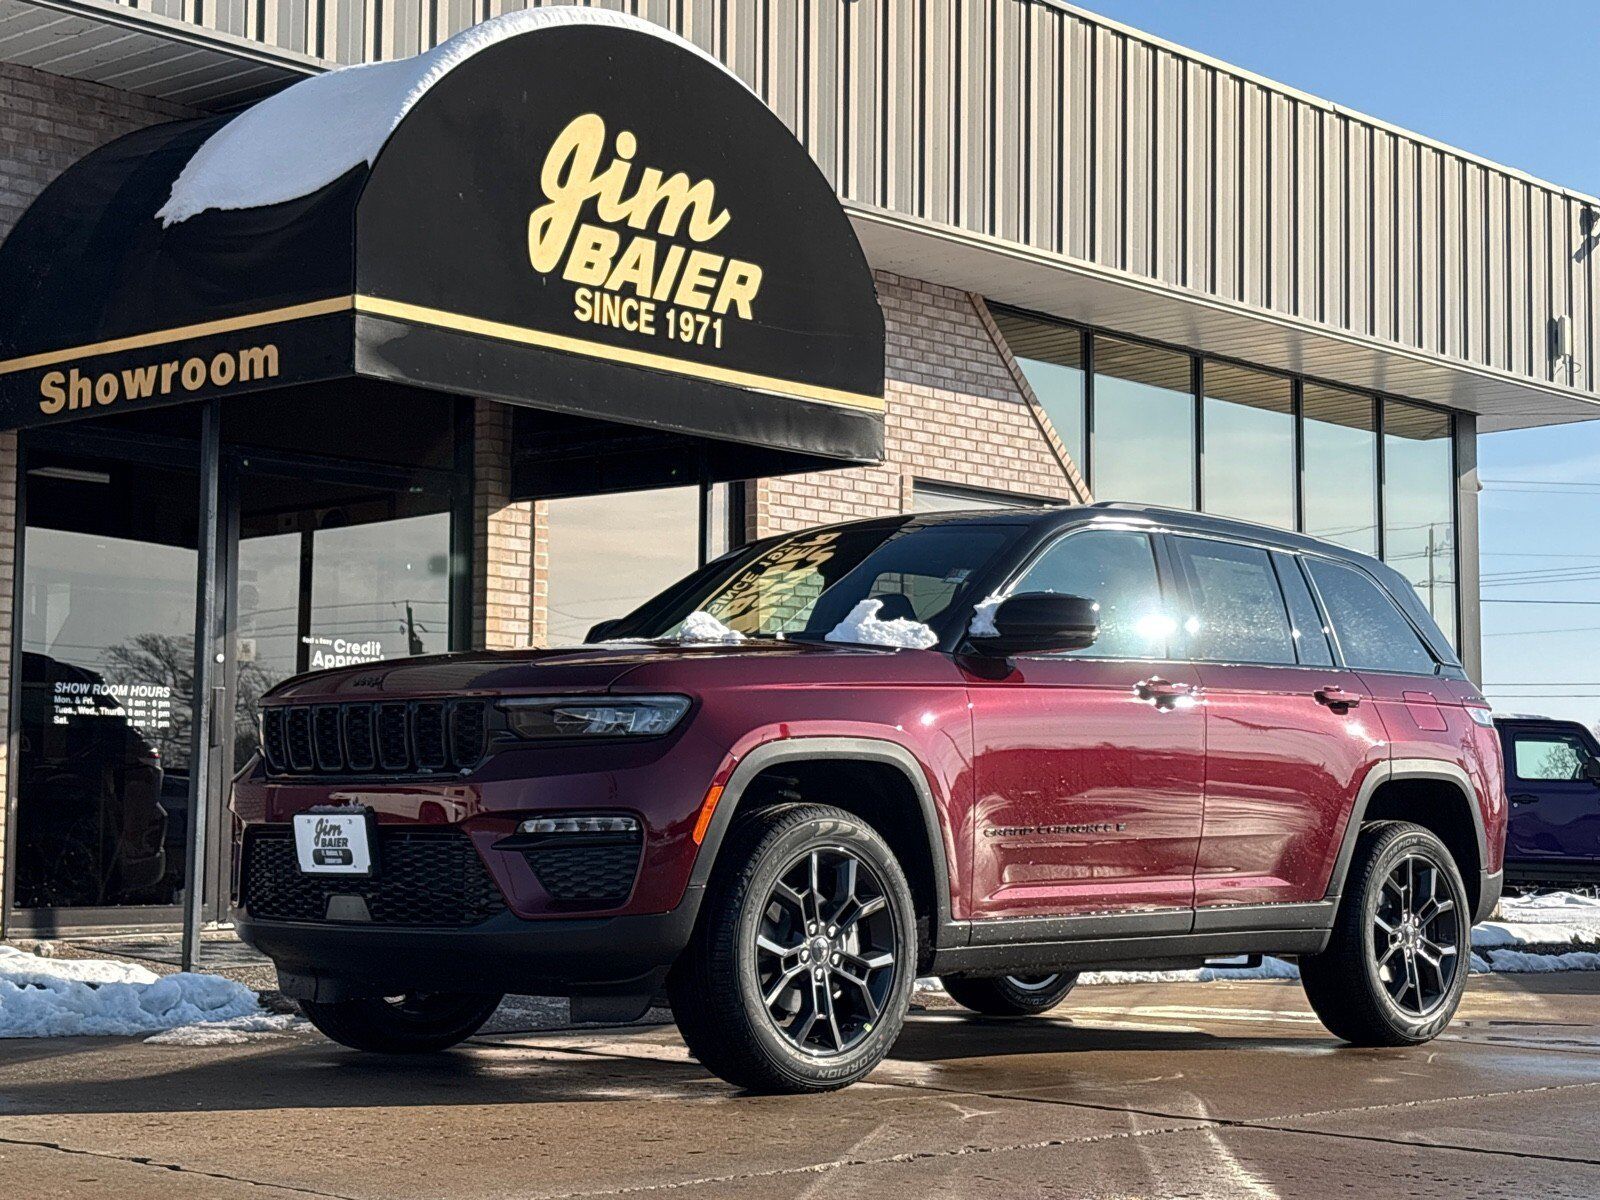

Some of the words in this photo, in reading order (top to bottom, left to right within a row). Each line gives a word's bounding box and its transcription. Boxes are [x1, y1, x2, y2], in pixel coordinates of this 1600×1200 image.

[528, 113, 731, 273] Jim
[563, 223, 763, 320] BAIER
[574, 287, 656, 336] SINCE
[666, 308, 722, 348] 1971
[39, 344, 279, 414] Showroom
[334, 639, 381, 655] Credit
[312, 650, 384, 669] Appro
[55, 682, 90, 694] SHOW
[92, 684, 128, 696] ROOM
[130, 686, 170, 698] HOURS
[54, 695, 73, 704] Mon.
[75, 696, 81, 704] &
[158, 701, 170, 709] pm
[53, 715, 69, 725] Sat.
[157, 720, 170, 729] pm
[158, 711, 170, 719] pm
[314, 817, 342, 847] Jim
[321, 838, 348, 848] BAIER
